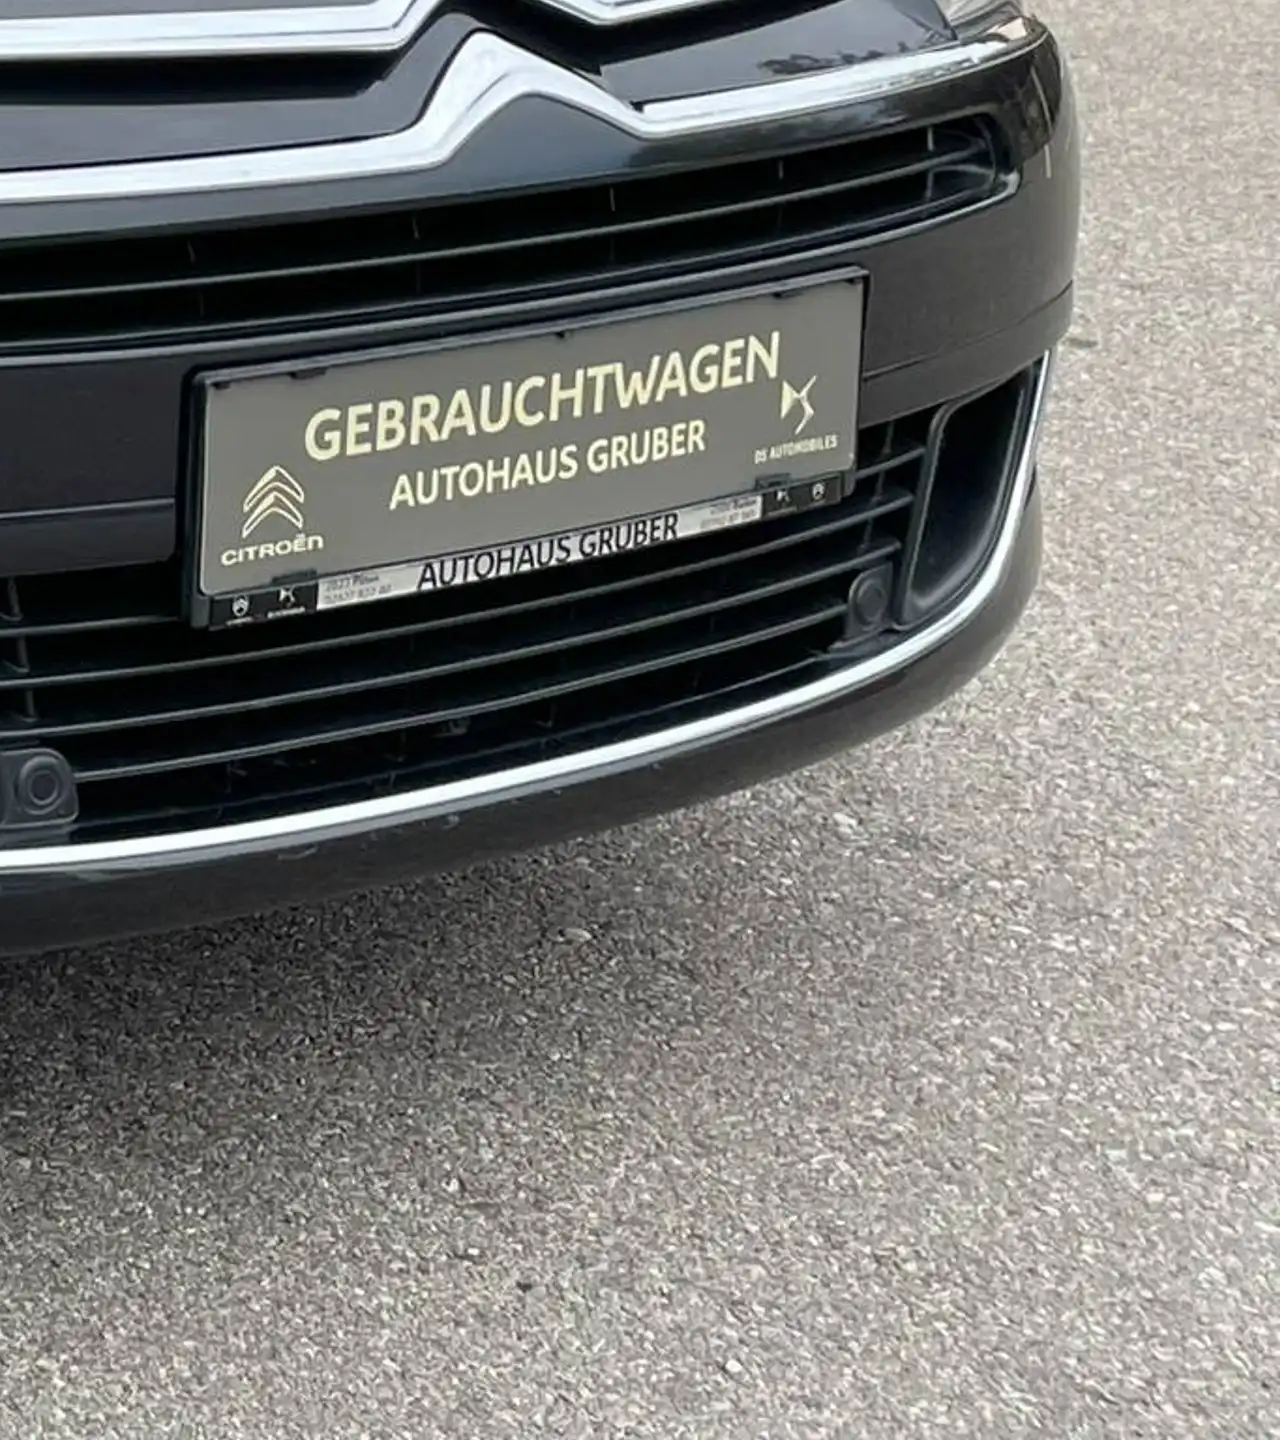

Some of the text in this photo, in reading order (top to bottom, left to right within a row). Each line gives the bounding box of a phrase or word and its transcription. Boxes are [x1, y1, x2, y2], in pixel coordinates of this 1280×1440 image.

[304, 331, 780, 461] GEBRAUCHTWAGEN
[389, 419, 707, 511] AUTOHAUS GRUBER
[417, 536, 571, 590] AUTOHAUS
[579, 512, 679, 558] GRUBER
